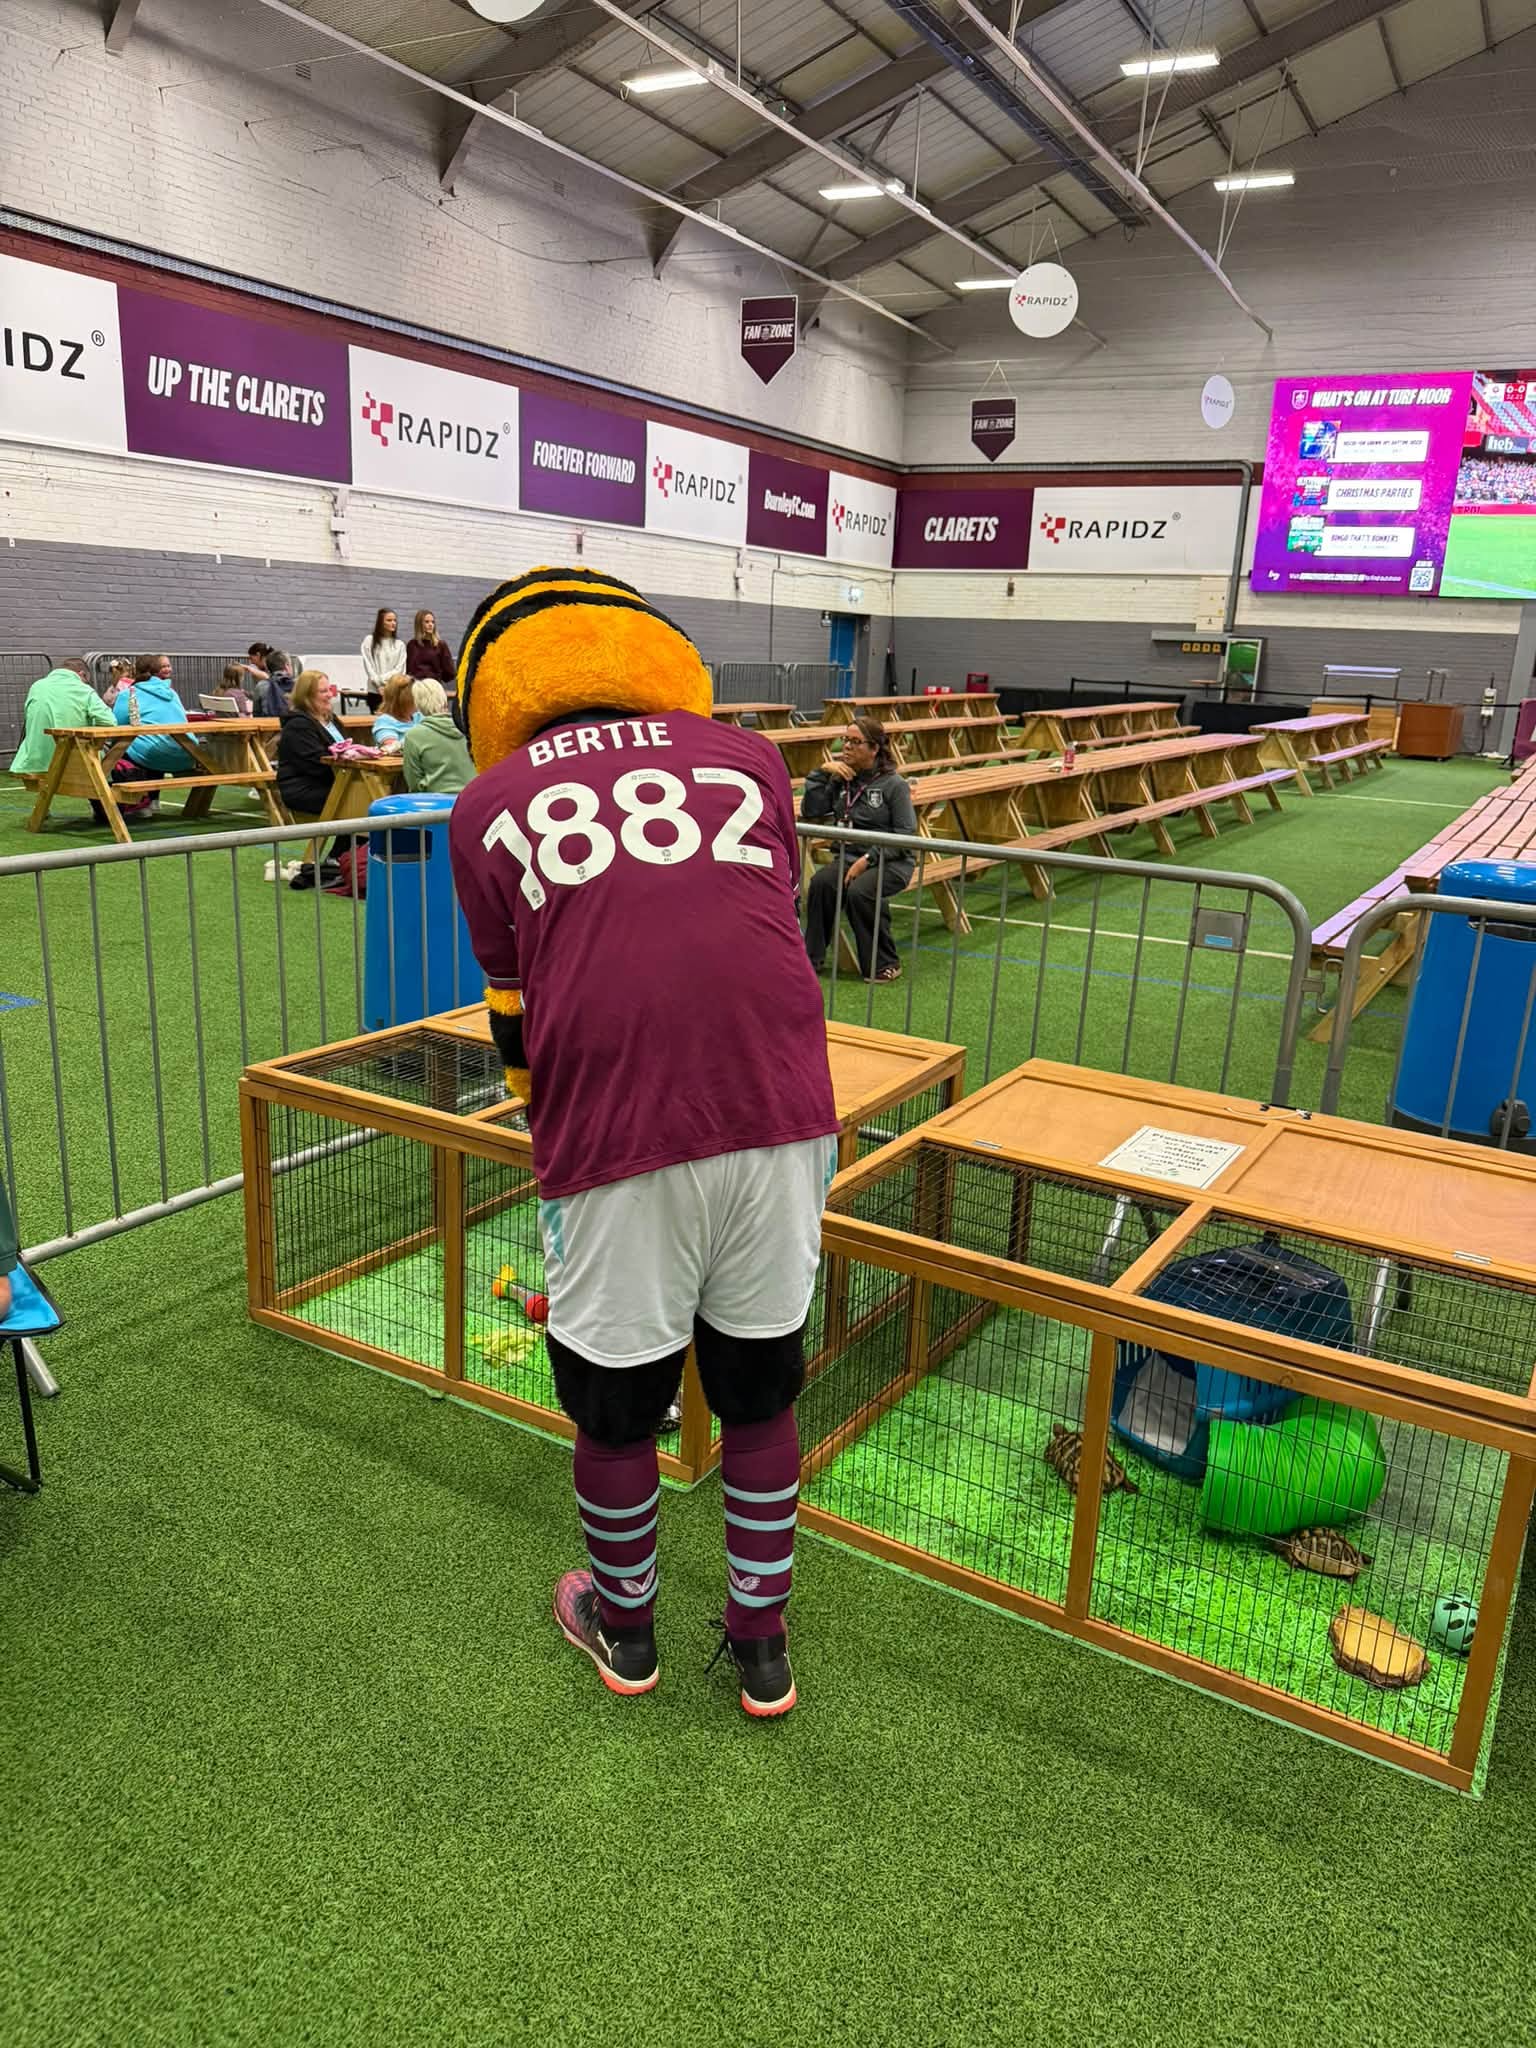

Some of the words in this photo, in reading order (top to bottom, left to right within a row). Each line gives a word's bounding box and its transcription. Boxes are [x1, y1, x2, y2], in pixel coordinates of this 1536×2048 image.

[744, 325, 761, 340] FAN
[770, 324, 794, 338] ZONE
[148, 355, 182, 396] UP
[188, 363, 232, 409] THE
[235, 375, 326, 427] CLARETS
[1312, 391, 1352, 408] WHAT'S
[1354, 390, 1369, 406] ON
[1369, 390, 1386, 406] AT
[1389, 389, 1417, 405] TURF
[1416, 388, 1452, 405] MOOR
[974, 419, 988, 430] FAN
[995, 418, 1014, 429] ZONE
[532, 440, 584, 475] FOREVER
[585, 453, 636, 484] FORWARD
[764, 489, 816, 520] BurnleyFC.com
[1336, 488, 1380, 499] CHRISTMAS
[1381, 487, 1414, 499] PARTIES
[924, 517, 1000, 542] CLARETS
[528, 721, 672, 767] BERTIE
[482, 767, 774, 911] 1882
